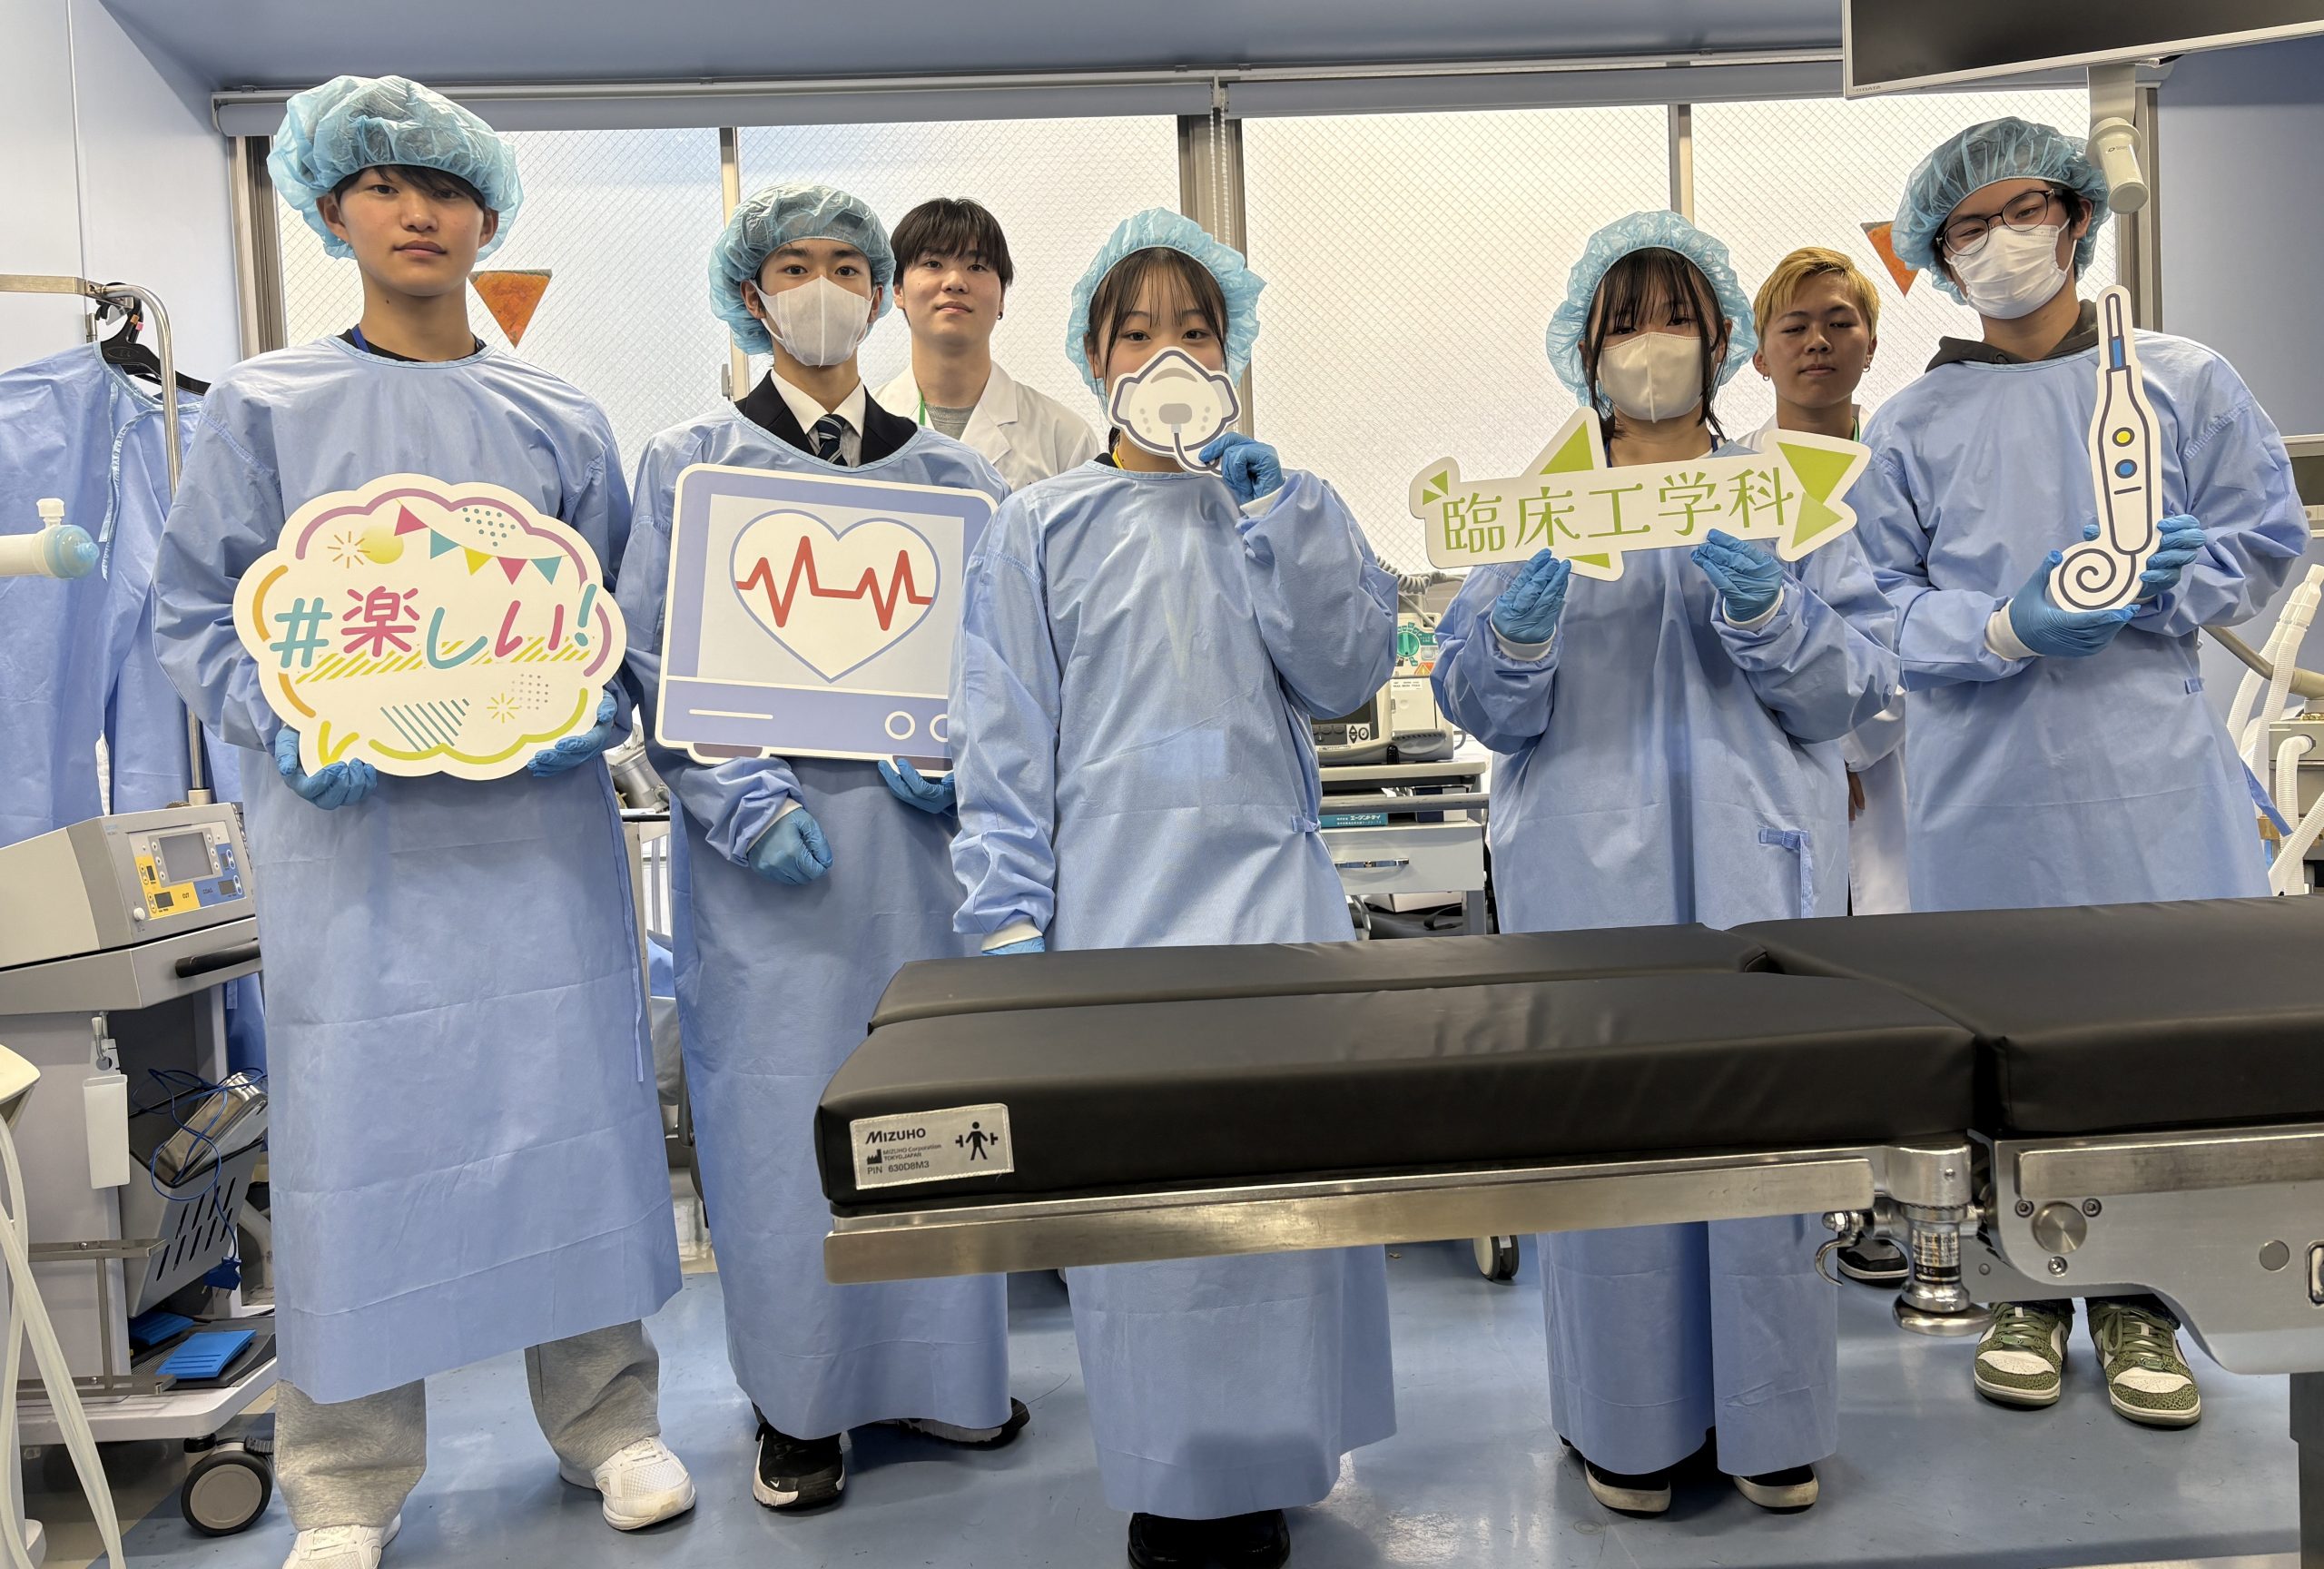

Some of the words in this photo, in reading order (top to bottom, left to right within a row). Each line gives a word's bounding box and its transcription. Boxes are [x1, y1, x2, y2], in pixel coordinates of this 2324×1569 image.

[1442, 466, 1795, 554] 臨床工学科
[269, 583, 597, 670] #楽しい!
[865, 1128, 926, 1144] MIZUHO
[883, 1147, 907, 1155] MIZUHO
[908, 1144, 942, 1153] Corporation
[888, 1160, 930, 1173] 630D8M3
